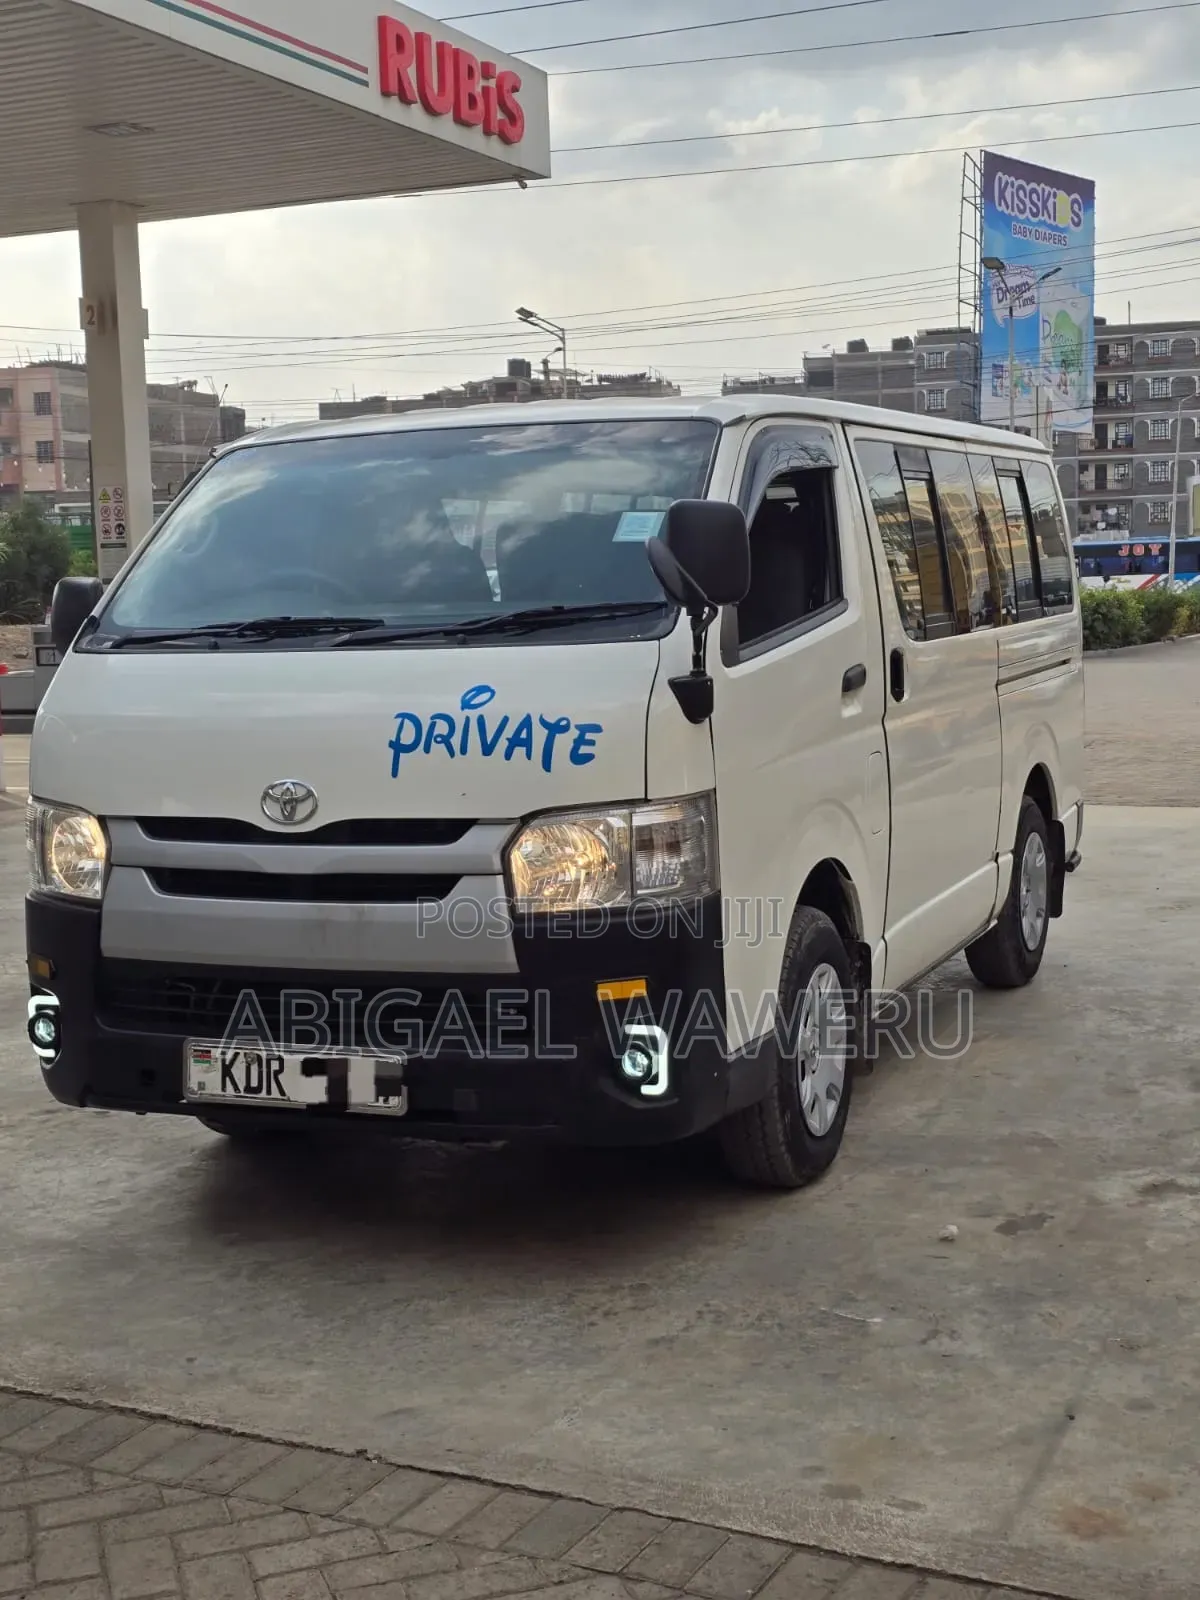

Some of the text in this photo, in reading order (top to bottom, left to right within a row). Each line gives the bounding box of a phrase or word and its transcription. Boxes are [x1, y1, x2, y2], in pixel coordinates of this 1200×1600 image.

[1012, 223, 1068, 247] BABY DIAPERS
[1017, 294, 1036, 309] Time
[86, 304, 96, 326] 2
[1118, 543, 1162, 557] JOY
[220, 1050, 288, 1097] KDR
